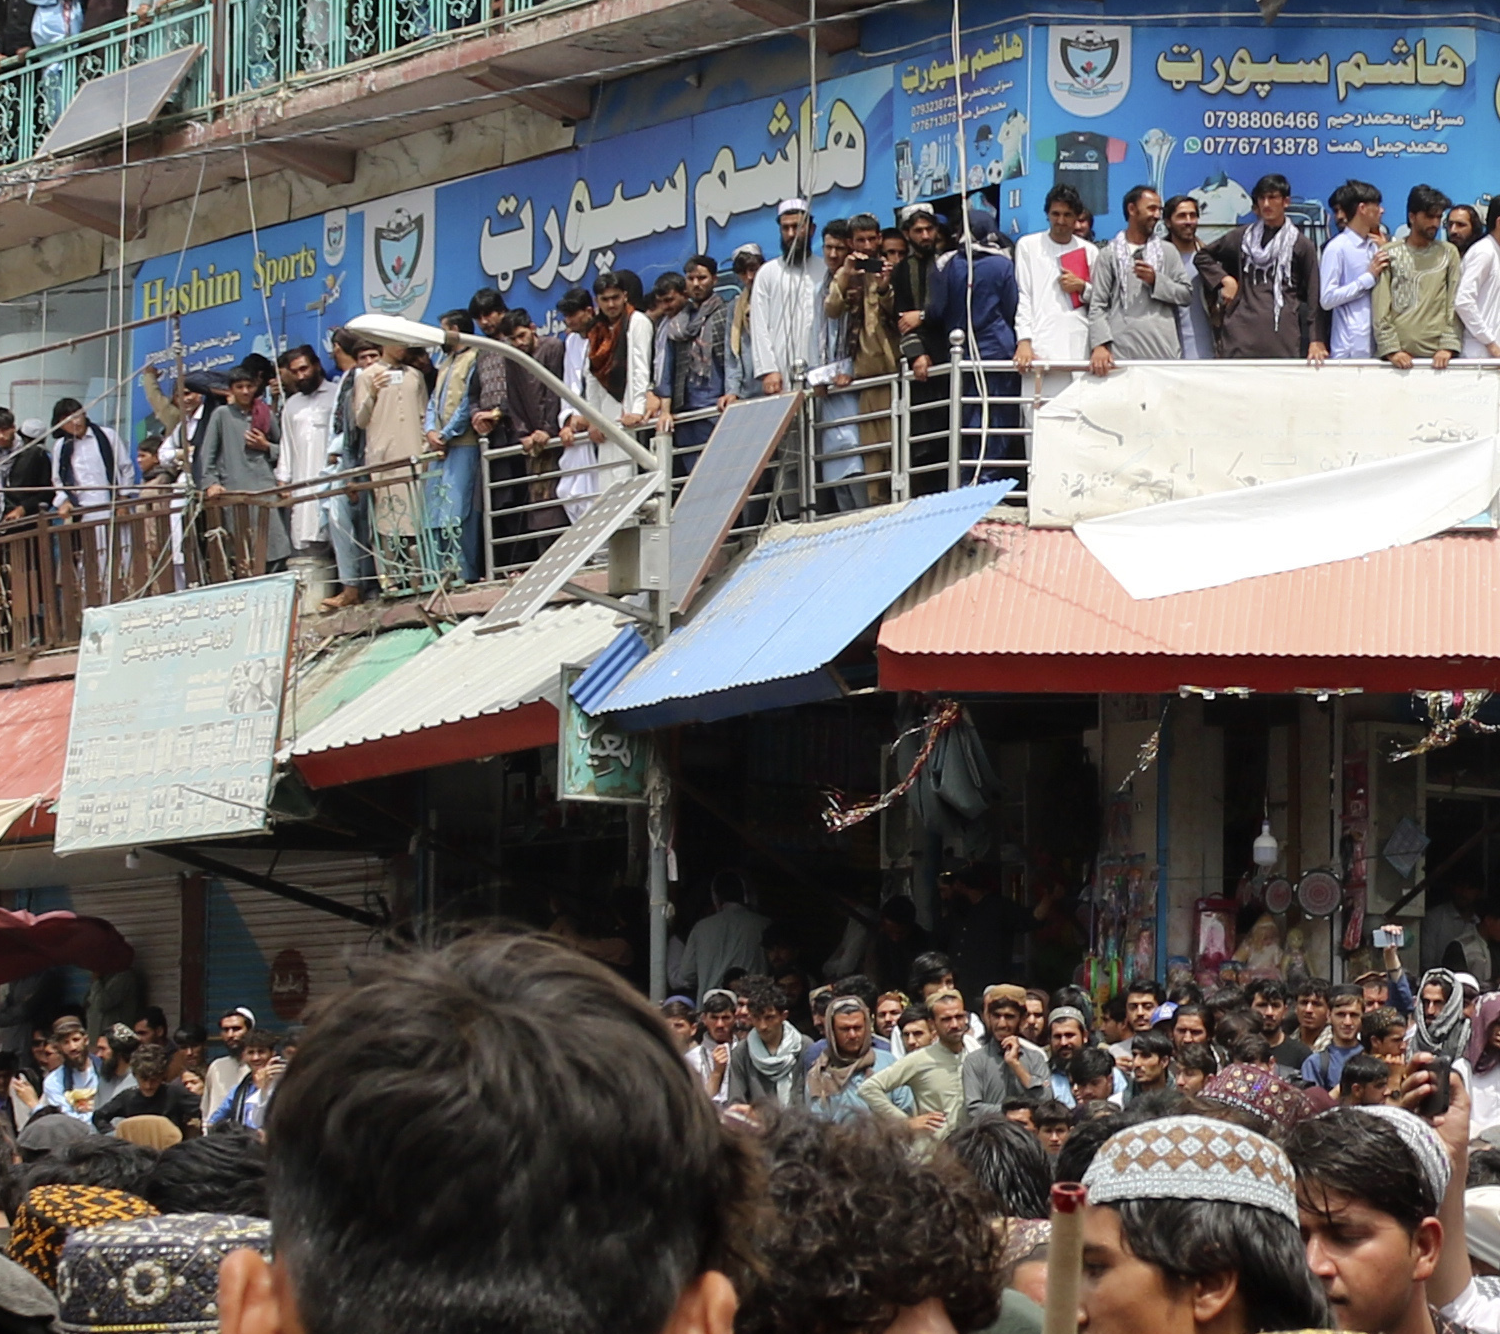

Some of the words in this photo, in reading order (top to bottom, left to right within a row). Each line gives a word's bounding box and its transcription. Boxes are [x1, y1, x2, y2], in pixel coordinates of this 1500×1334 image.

[971, 32, 1024, 82] هاشم
[1336, 38, 1466, 101] هاشم
[1203, 110, 1319, 129] 0798806466
[1203, 136, 1319, 155] 0776713878
[696, 93, 867, 254] هاشم
[141, 263, 242, 319] Hashim
[252, 242, 317, 299] Sports
